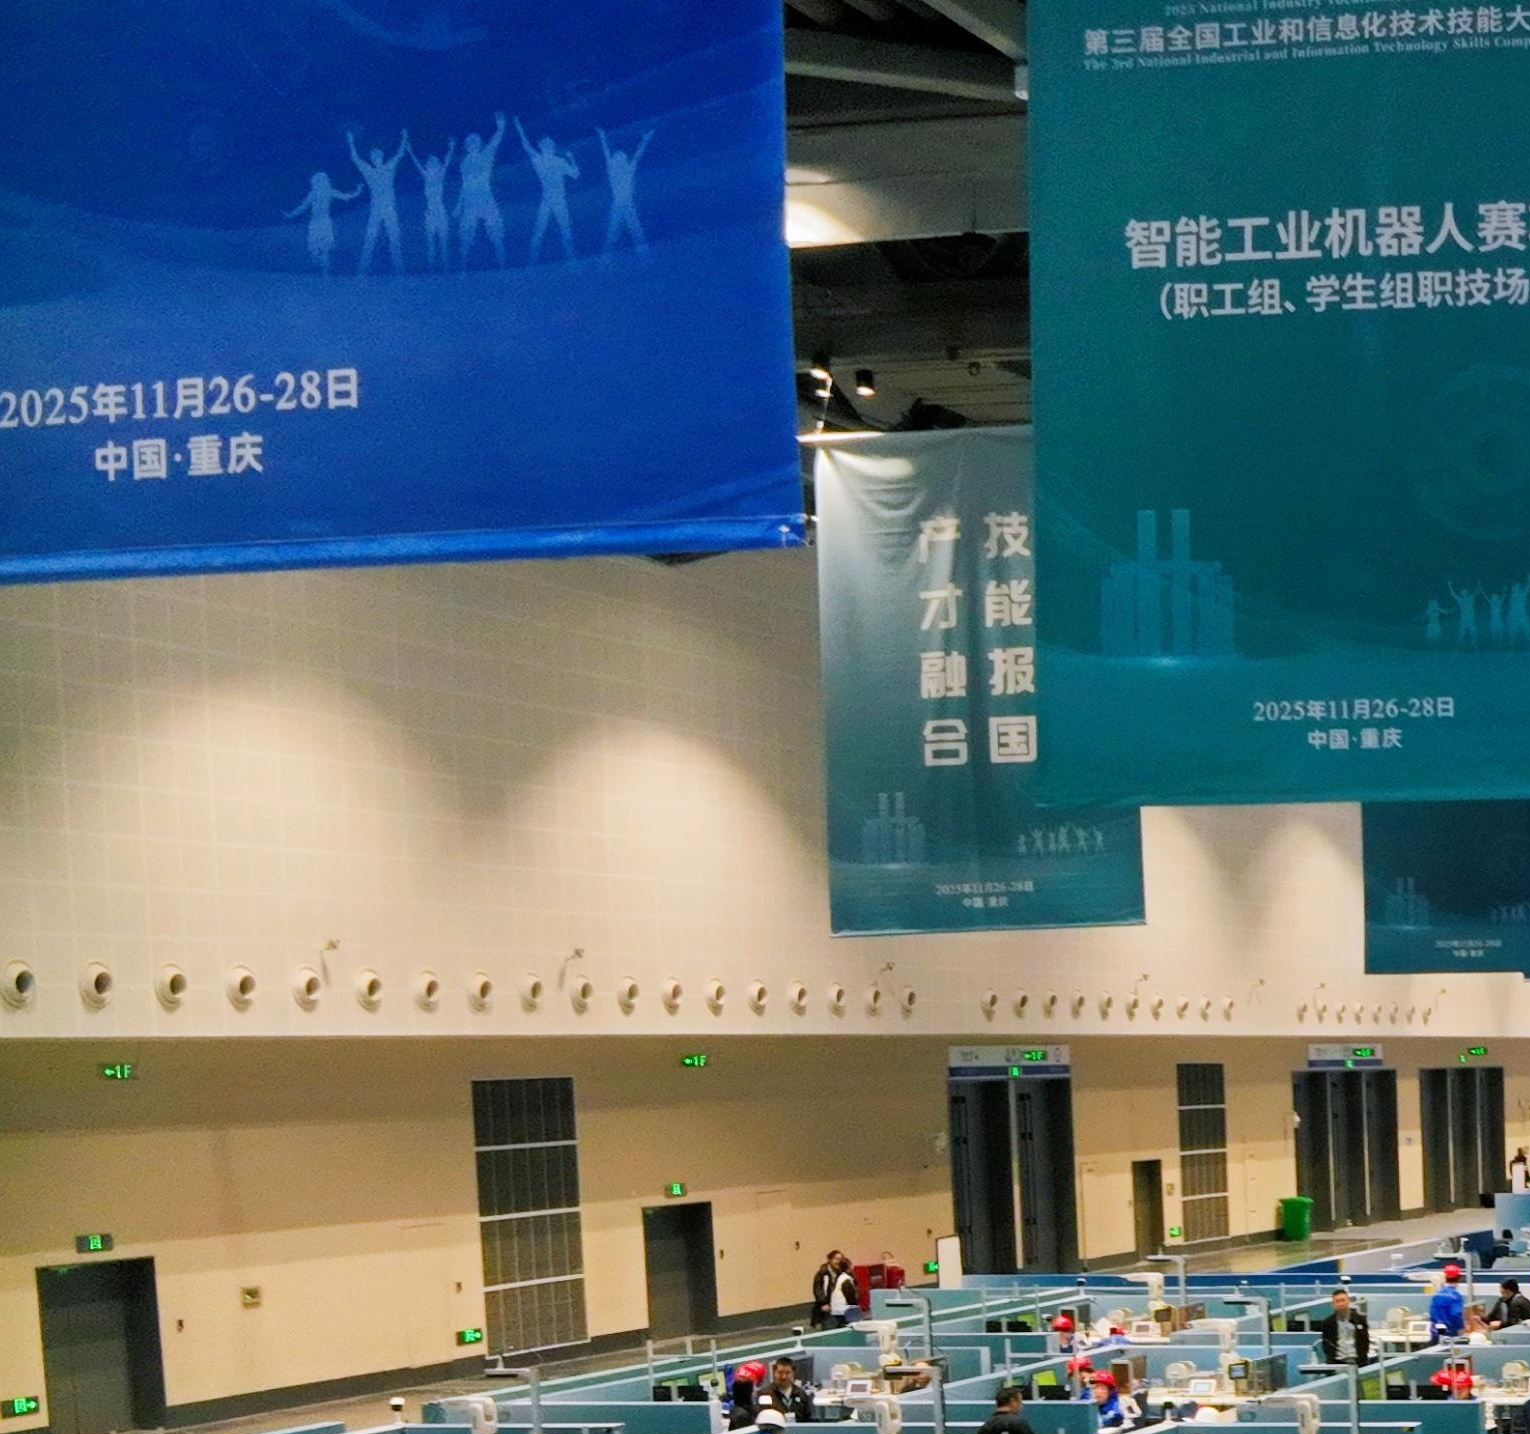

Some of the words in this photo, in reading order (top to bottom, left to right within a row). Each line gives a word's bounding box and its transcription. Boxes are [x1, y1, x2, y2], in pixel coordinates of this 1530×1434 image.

[1139, 52, 1193, 67] National
[1196, 48, 1260, 64] Industrial
[1292, 43, 1369, 58] Information
[1374, 39, 1448, 54] Technology
[1452, 36, 1490, 49] Skills
[0, 367, 360, 430] 2025年11月26-28日
[94, 432, 265, 483] 中国·重庆
[917, 508, 968, 767] 产才融合
[983, 511, 1038, 764] 技能报国
[1253, 696, 1455, 723] 2025年11月26-28日
[1306, 726, 1403, 750] 中国·重庆
